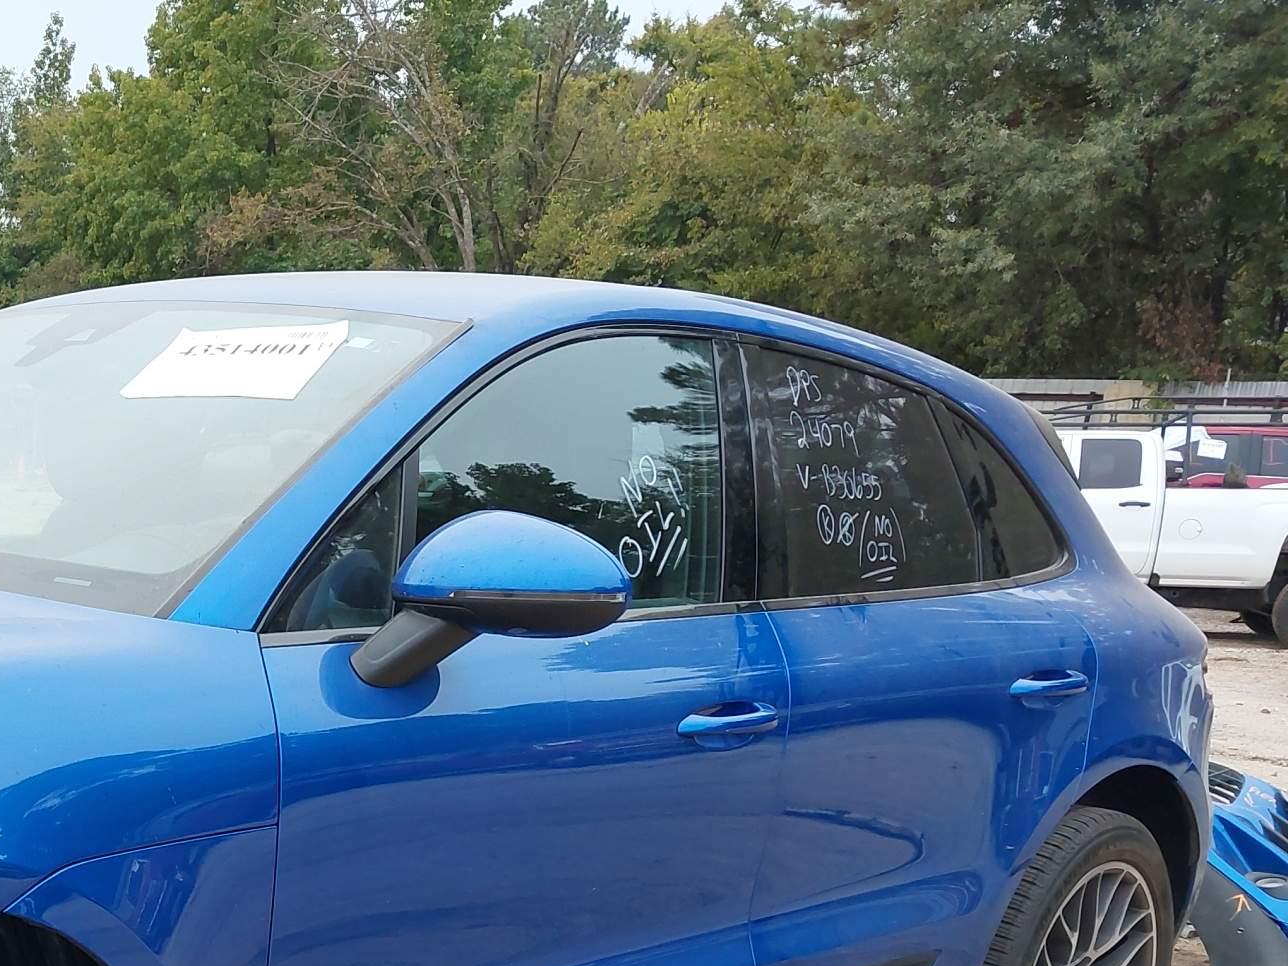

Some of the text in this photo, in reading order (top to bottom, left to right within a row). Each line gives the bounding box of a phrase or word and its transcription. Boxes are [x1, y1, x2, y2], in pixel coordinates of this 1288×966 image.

[786, 366, 822, 406] DPS
[789, 411, 860, 456] 24079
[619, 454, 658, 520] NO
